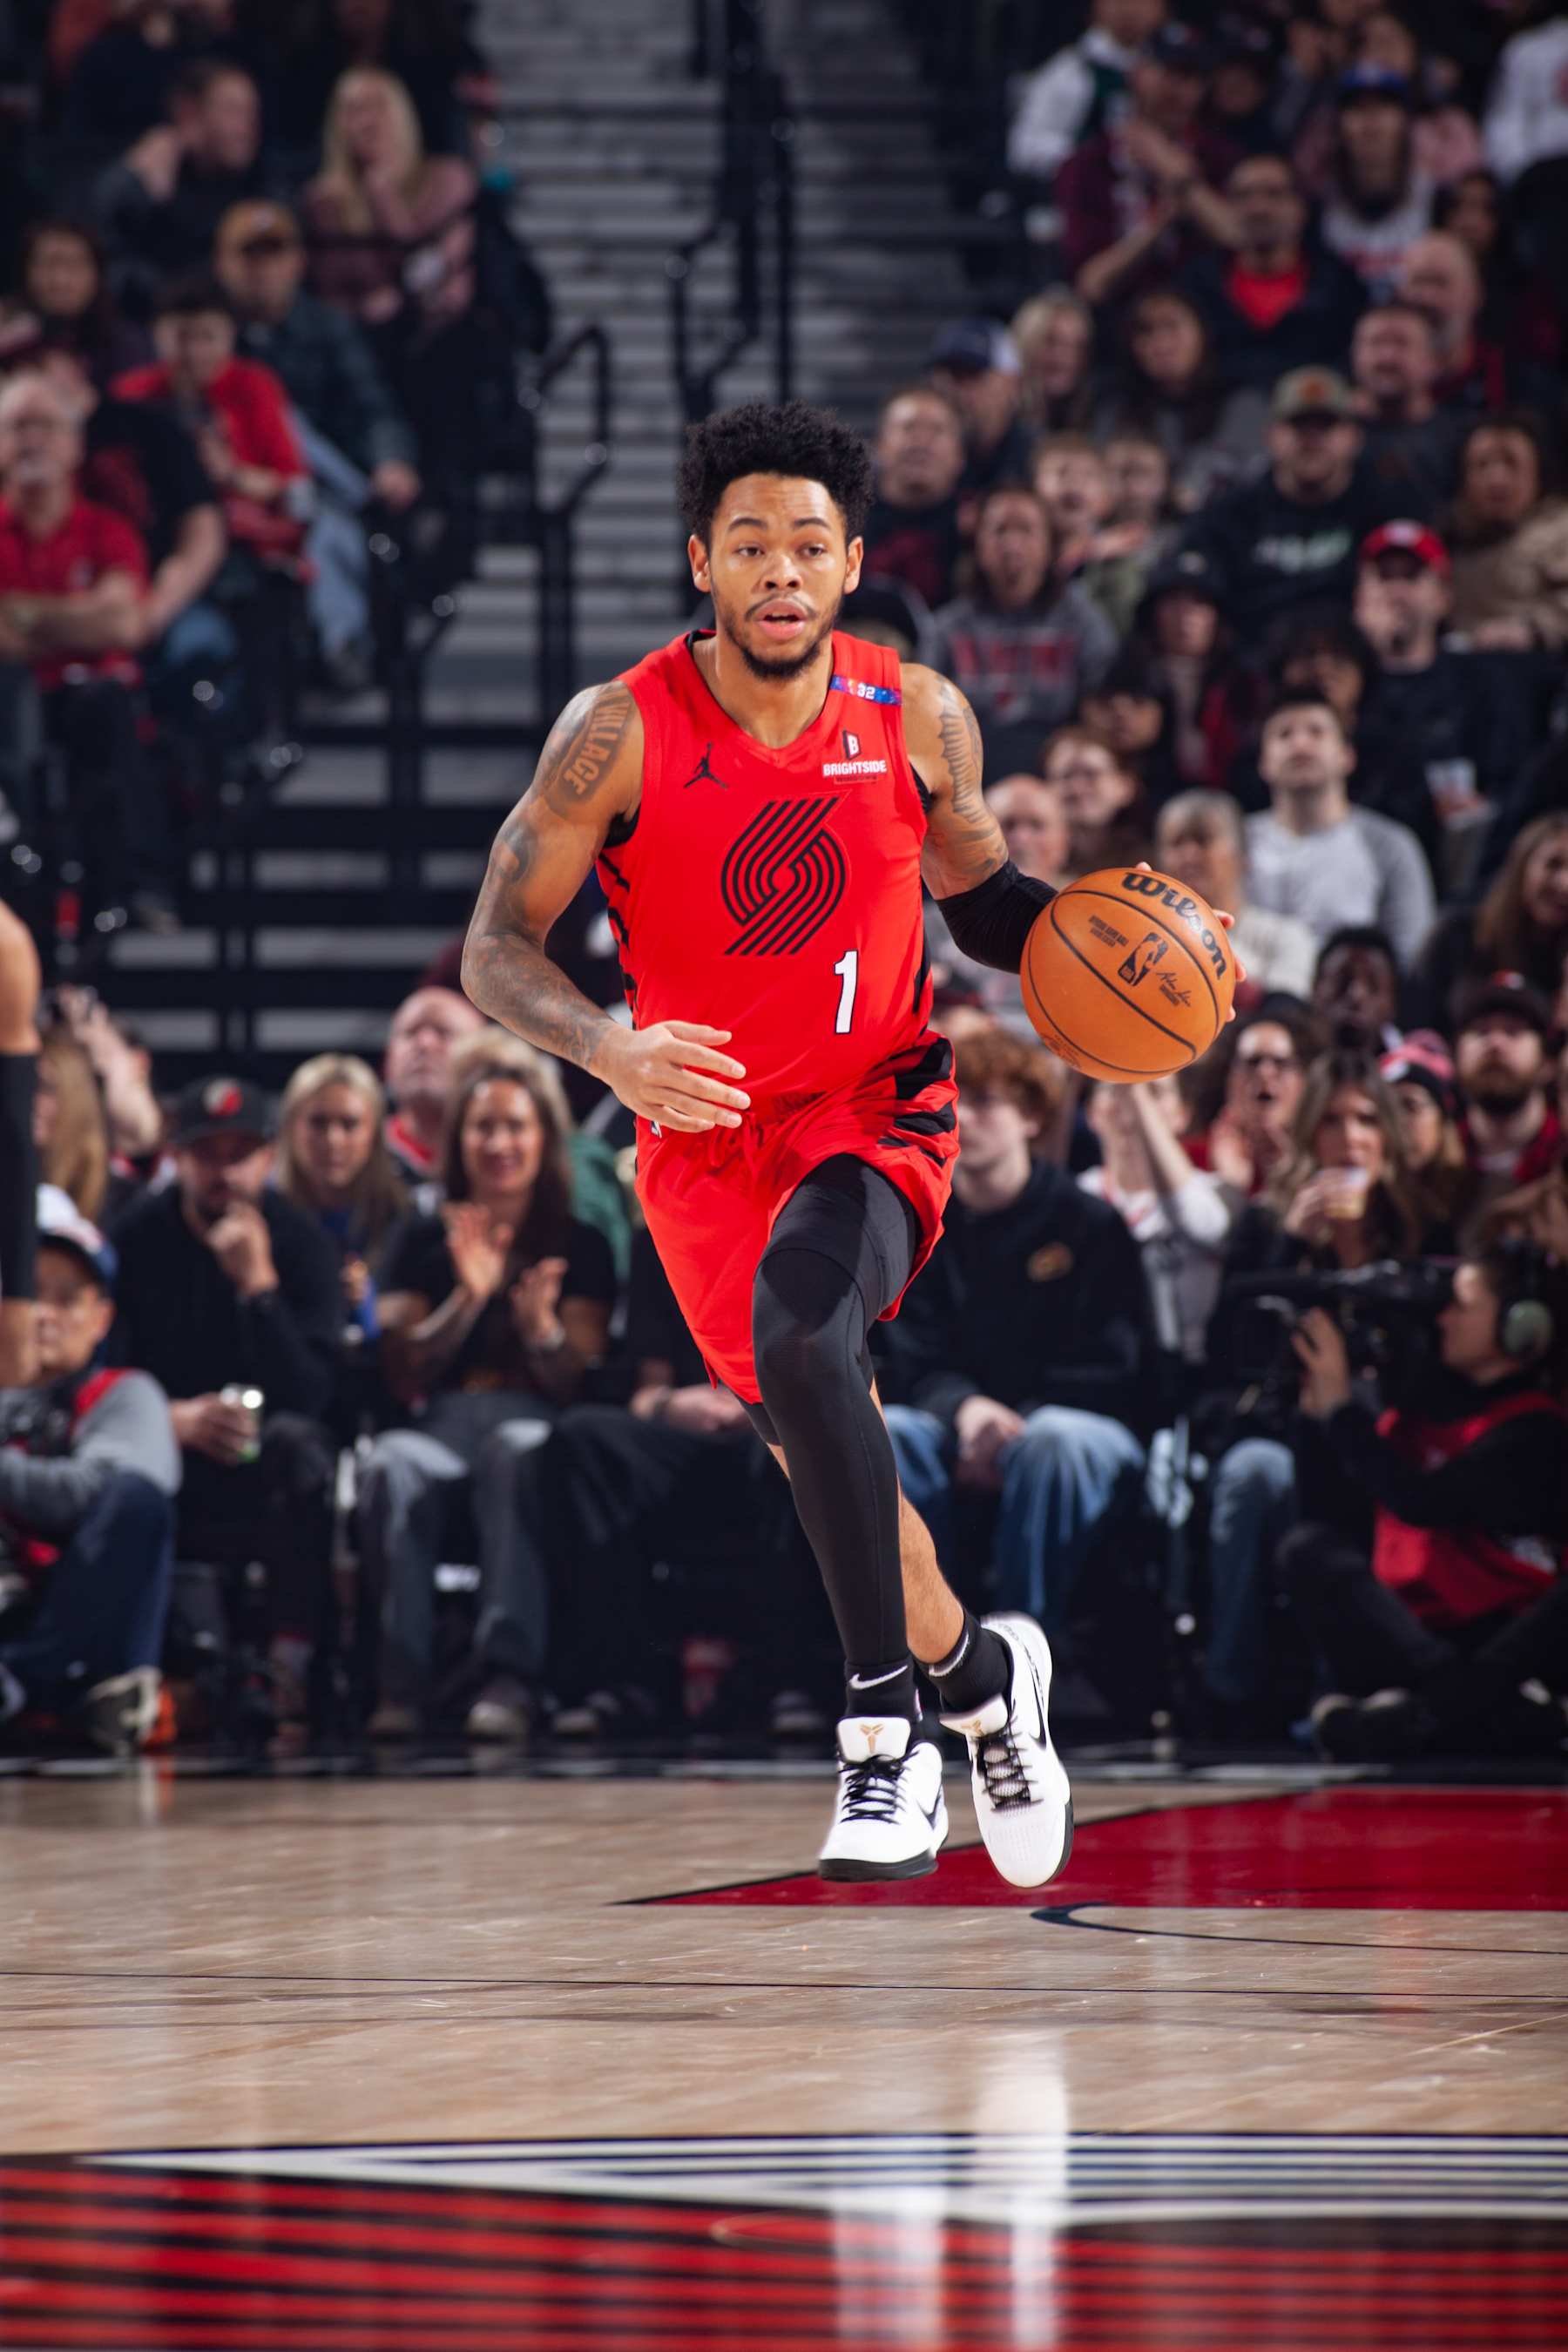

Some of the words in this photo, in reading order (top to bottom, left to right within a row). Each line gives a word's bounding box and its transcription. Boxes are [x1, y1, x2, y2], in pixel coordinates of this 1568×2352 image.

[857, 682, 876, 700] 32
[848, 734, 860, 755] B
[822, 760, 887, 777] BRIGHTSIDE
[834, 950, 858, 1034] 1
